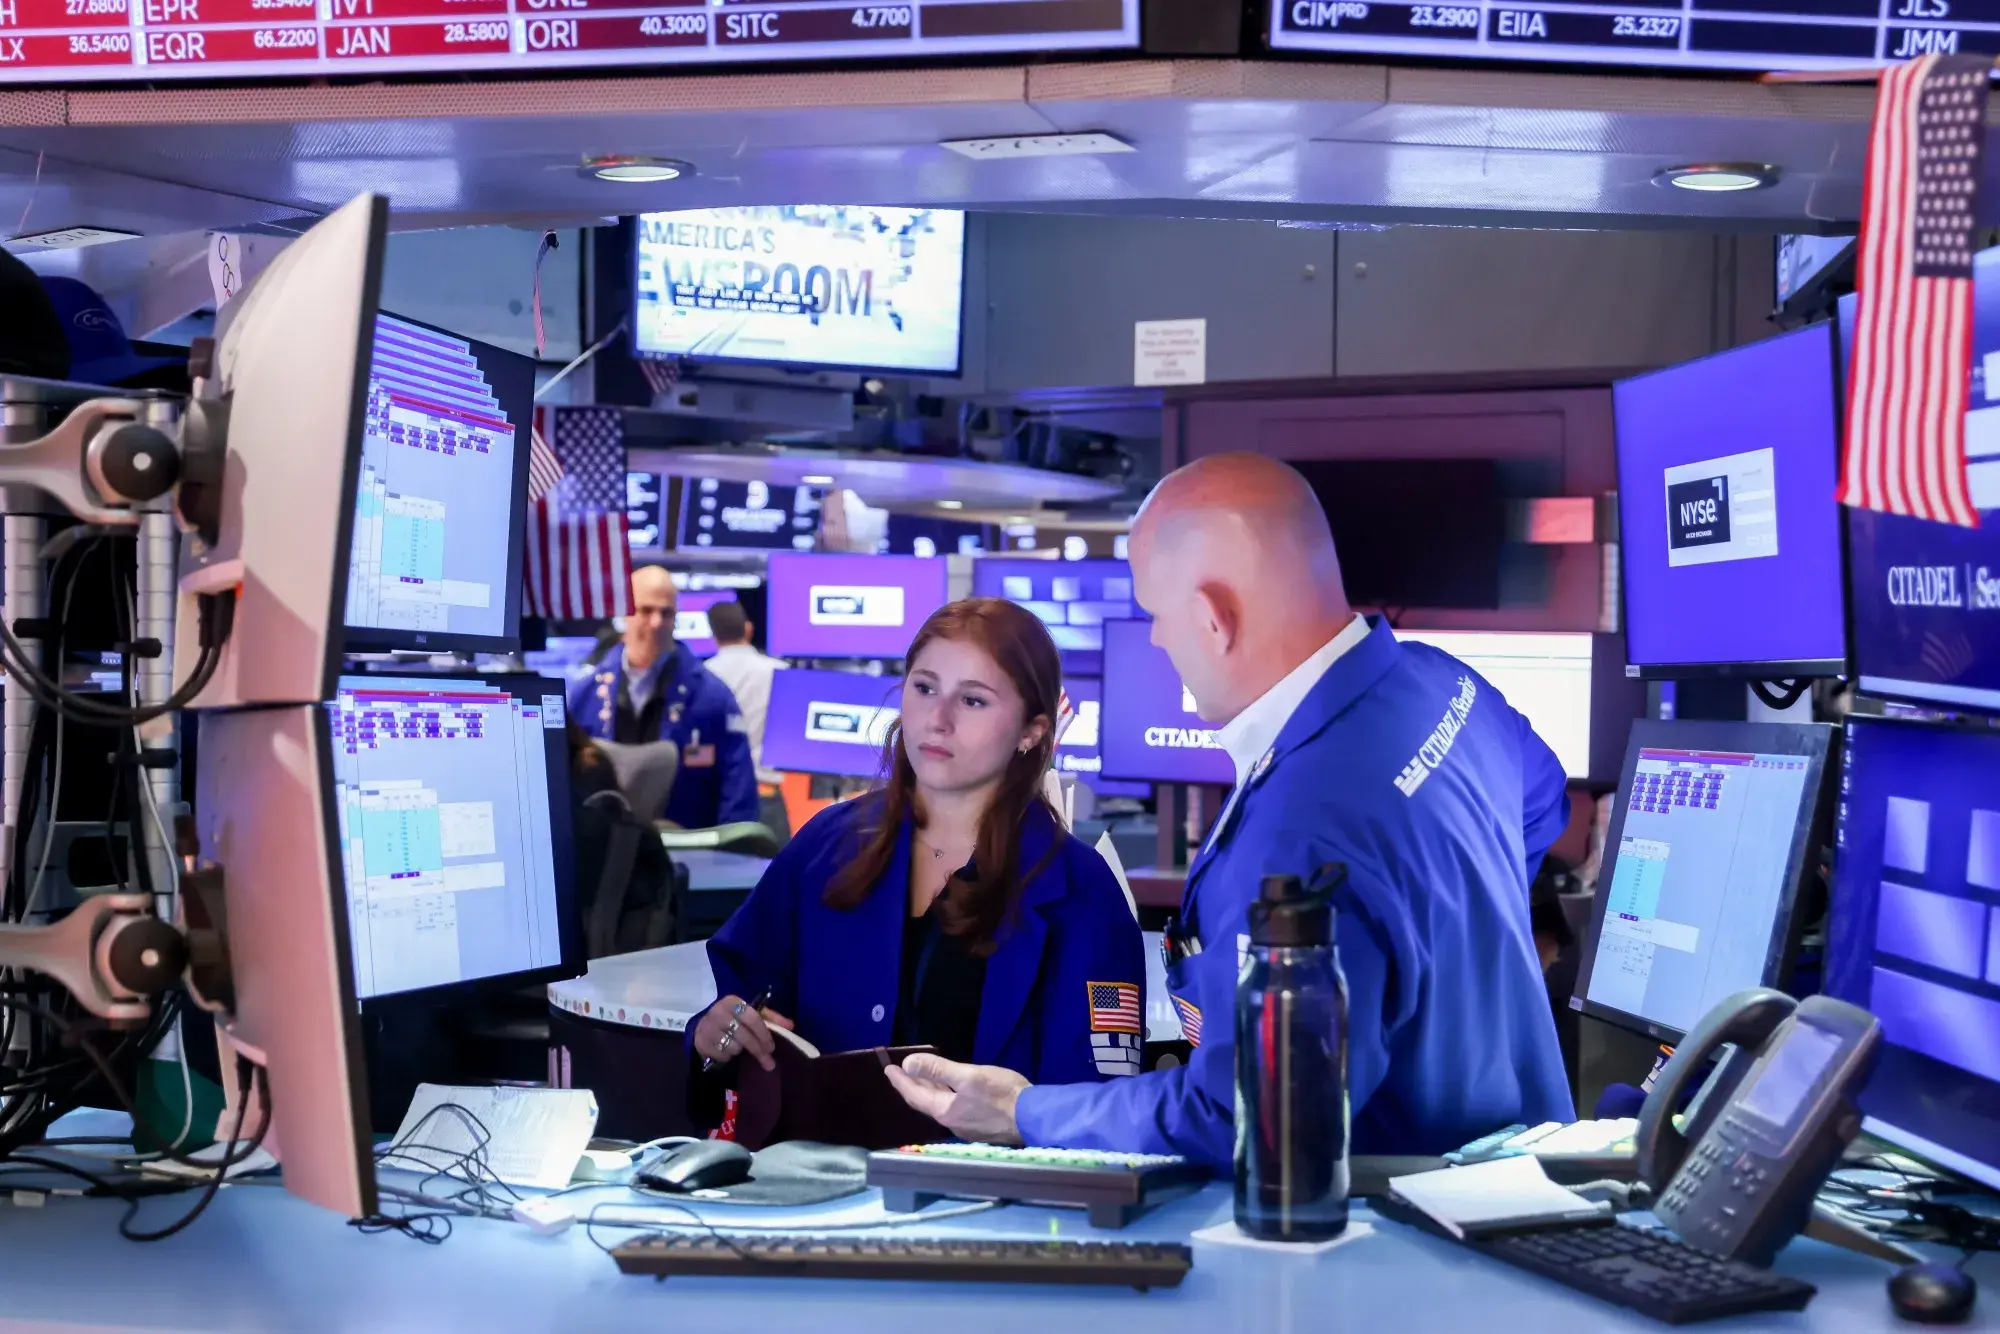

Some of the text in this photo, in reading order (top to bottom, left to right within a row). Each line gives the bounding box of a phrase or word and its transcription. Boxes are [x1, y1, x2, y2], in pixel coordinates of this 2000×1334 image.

[147, 0, 199, 22] EPR
[726, 7, 911, 40] SITC 4.7700
[1410, 7, 1478, 28] 23.2900
[1499, 10, 1680, 38] EIIA 25.2327
[69, 34, 130, 53] 36.5400
[151, 29, 316, 61] EQR 66.2200
[336, 22, 507, 56] JAN 28.5800
[528, 15, 706, 49] ORI 40.3000
[1894, 29, 1958, 56] JMM
[1887, 566, 1962, 607] CITADEL
[1418, 709, 1462, 769] CITADEL
